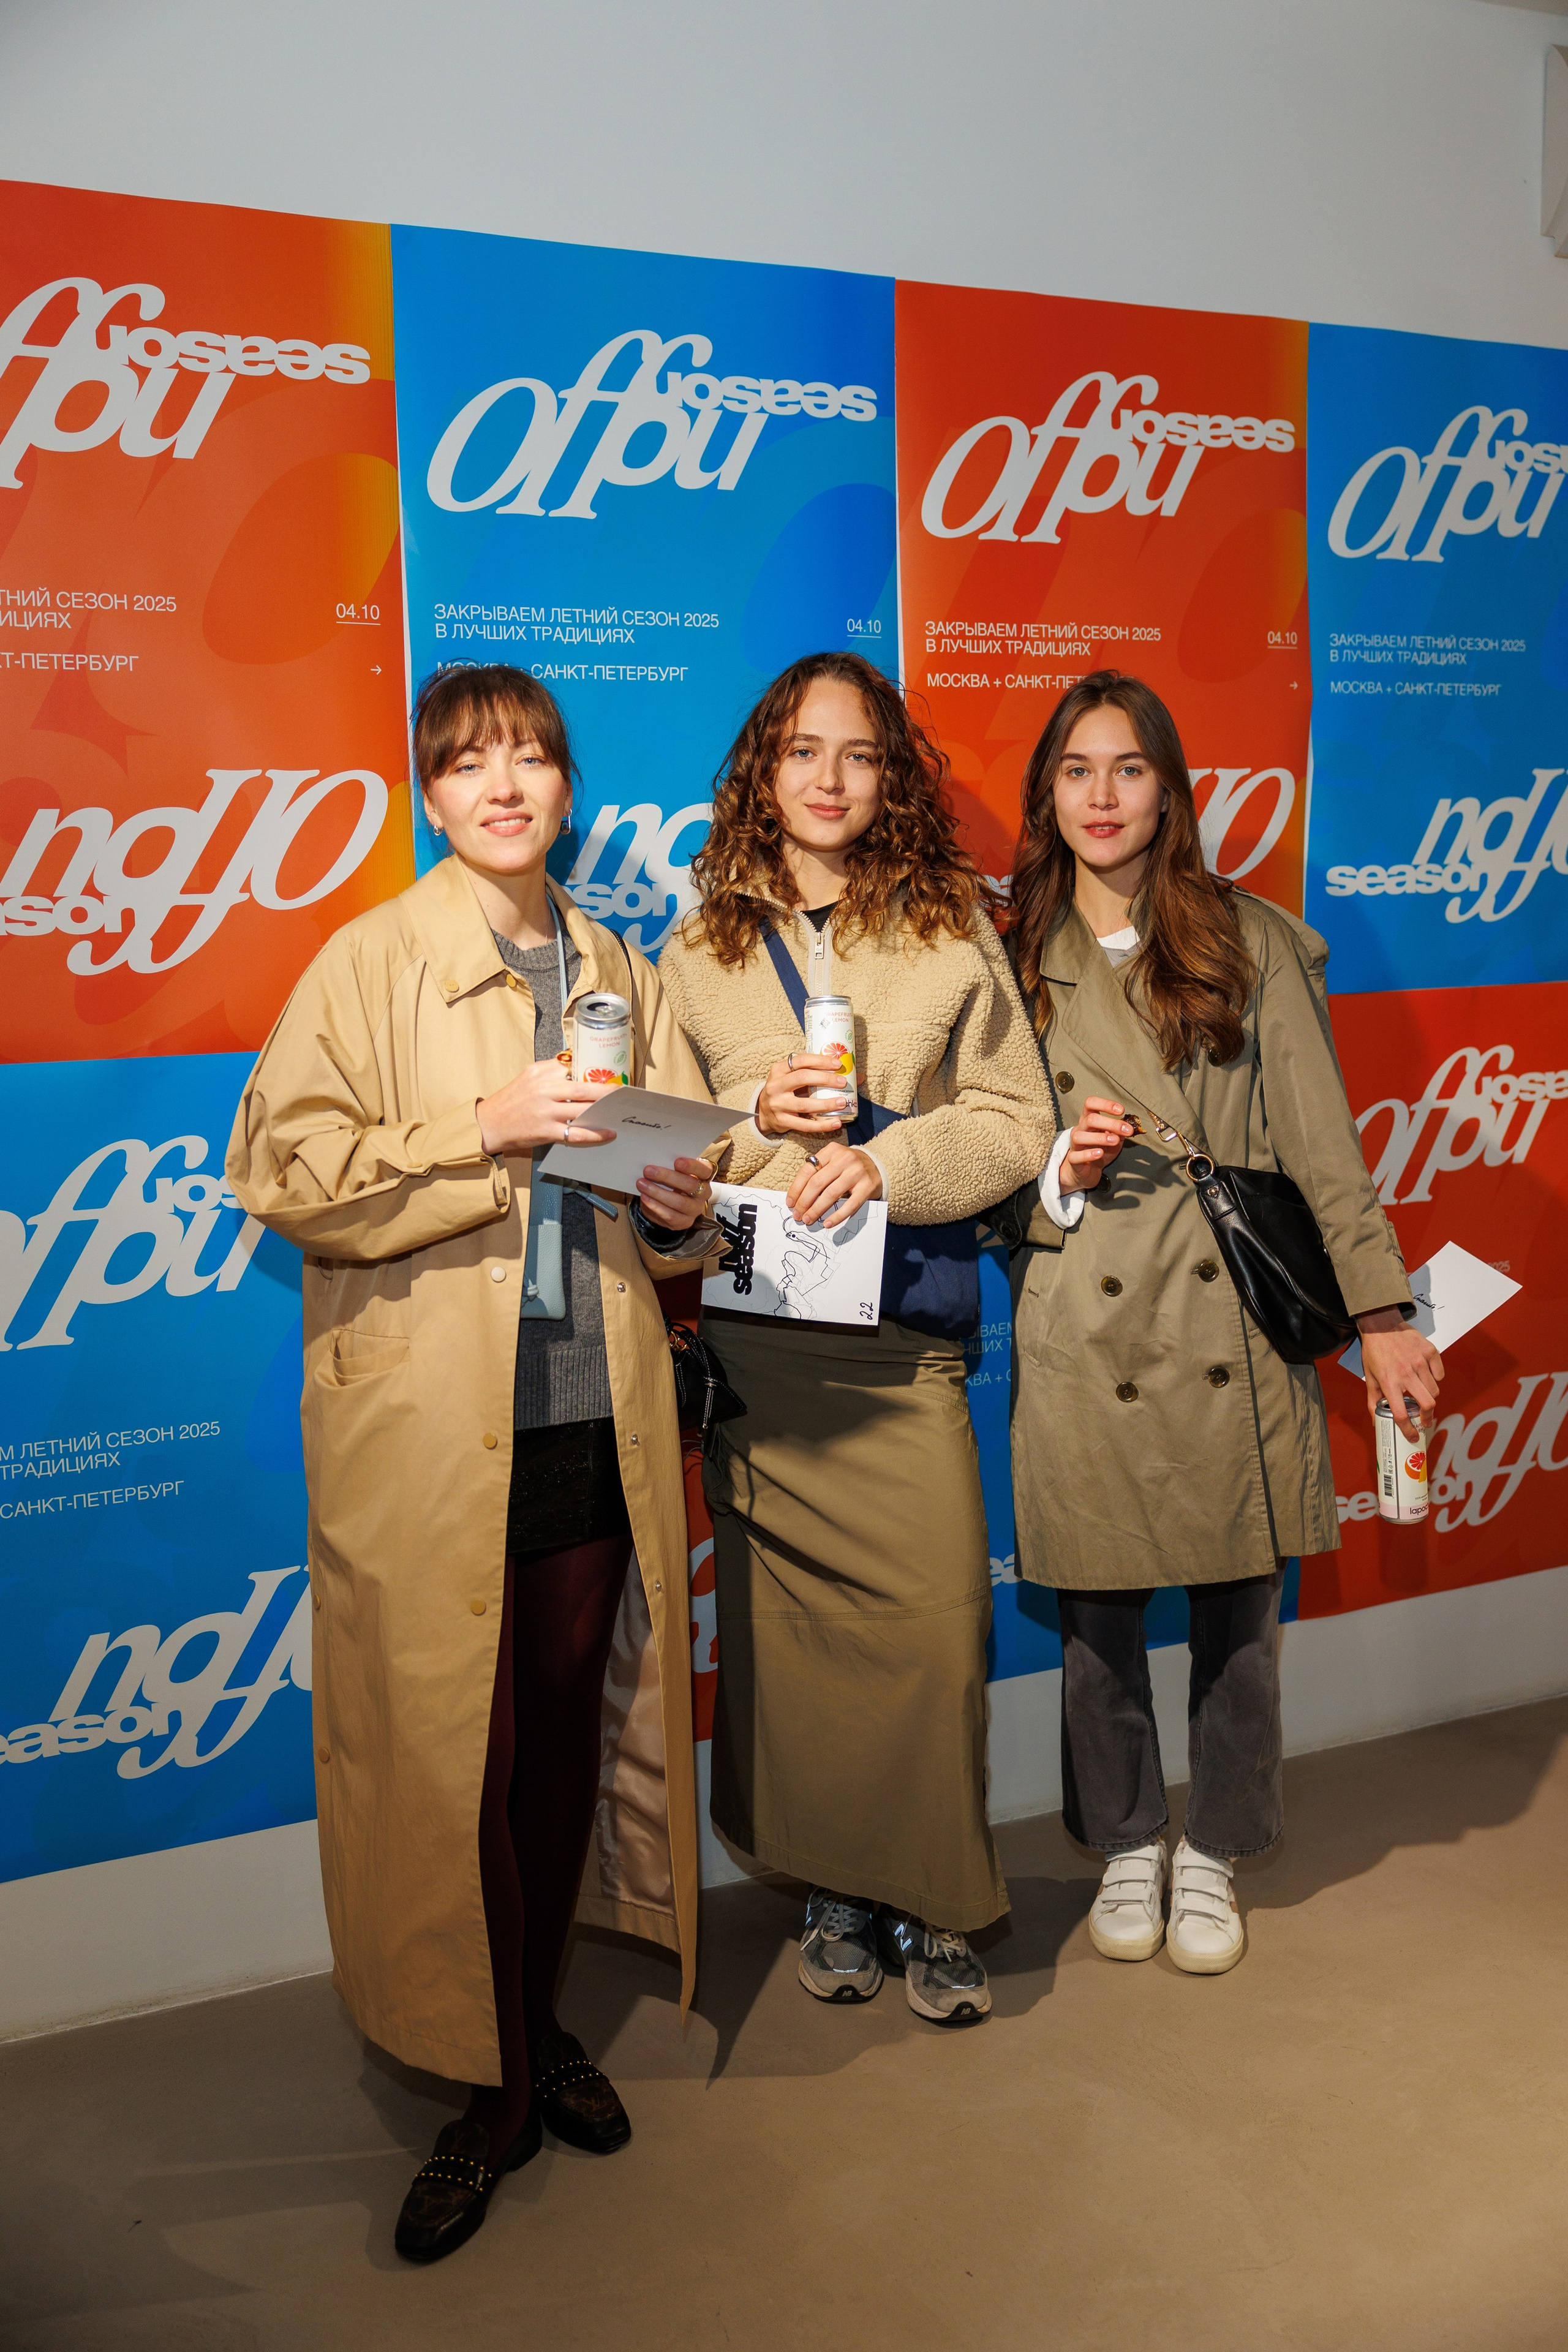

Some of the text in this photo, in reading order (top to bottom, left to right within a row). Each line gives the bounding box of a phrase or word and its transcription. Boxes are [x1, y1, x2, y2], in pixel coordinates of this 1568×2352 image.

[56, 592, 128, 610] СЕЗОН
[134, 595, 177, 612] 2025
[336, 603, 380, 620] 04.10
[434, 603, 719, 628] ЗАКРЫВАЕМ ЛЕТНИЙ СЕЗОН 2025
[435, 624, 635, 646] В ЛУЧШИХ ТРАДИЦИЯХ
[847, 619, 881, 633] 04.10
[925, 620, 1161, 641] ЗАКРЫВАЕМ ЛЕТНИЙ СЕЗОН 2025
[925, 638, 1091, 657] В ЛУЧШИХ ТРАДИЦИЯХ
[1267, 631, 1297, 645] 04.10
[1330, 633, 1526, 652] ЗАКРЫВАЕМ ЛЕТНИЙ СЕЗОН 2025
[1330, 649, 1466, 665] В ЛУЧШИХ ТРАДИЦИЯХ
[531, 663, 688, 681] САНКТ-ПЕТЕРБУРГ
[927, 673, 990, 688] МОСКВА
[1330, 680, 1383, 694] МОСКВА
[1395, 682, 1501, 696] САНКТ-ПЕТЕРБУРГ
[1325, 863, 1496, 896] season
[20, 1431, 100, 1459] ЛЕТНИЙ
[106, 1426, 174, 1448] СЕЗОН
[179, 1421, 221, 1439] 2025
[0, 1451, 121, 1480] ТРАДИЦИЯХ
[0, 1480, 184, 1519] САНКТ-ПЕТЕРБУРГ
